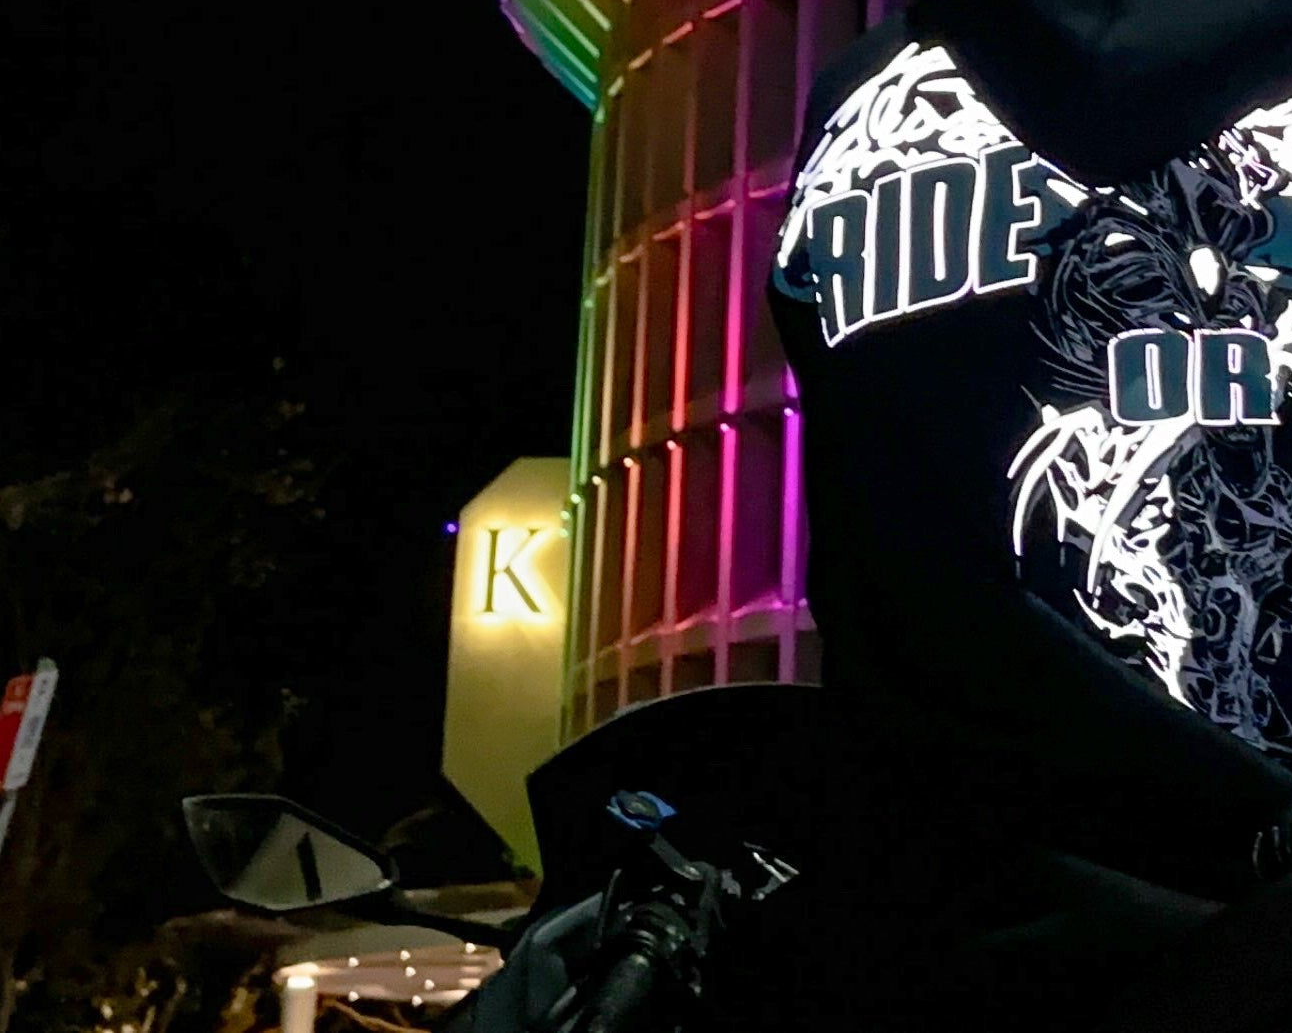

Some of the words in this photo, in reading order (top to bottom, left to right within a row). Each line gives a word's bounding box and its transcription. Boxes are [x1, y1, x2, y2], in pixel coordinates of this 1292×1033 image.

[805, 140, 1041, 348] RIDE
[1107, 327, 1281, 428] OR
[481, 529, 543, 614] K
